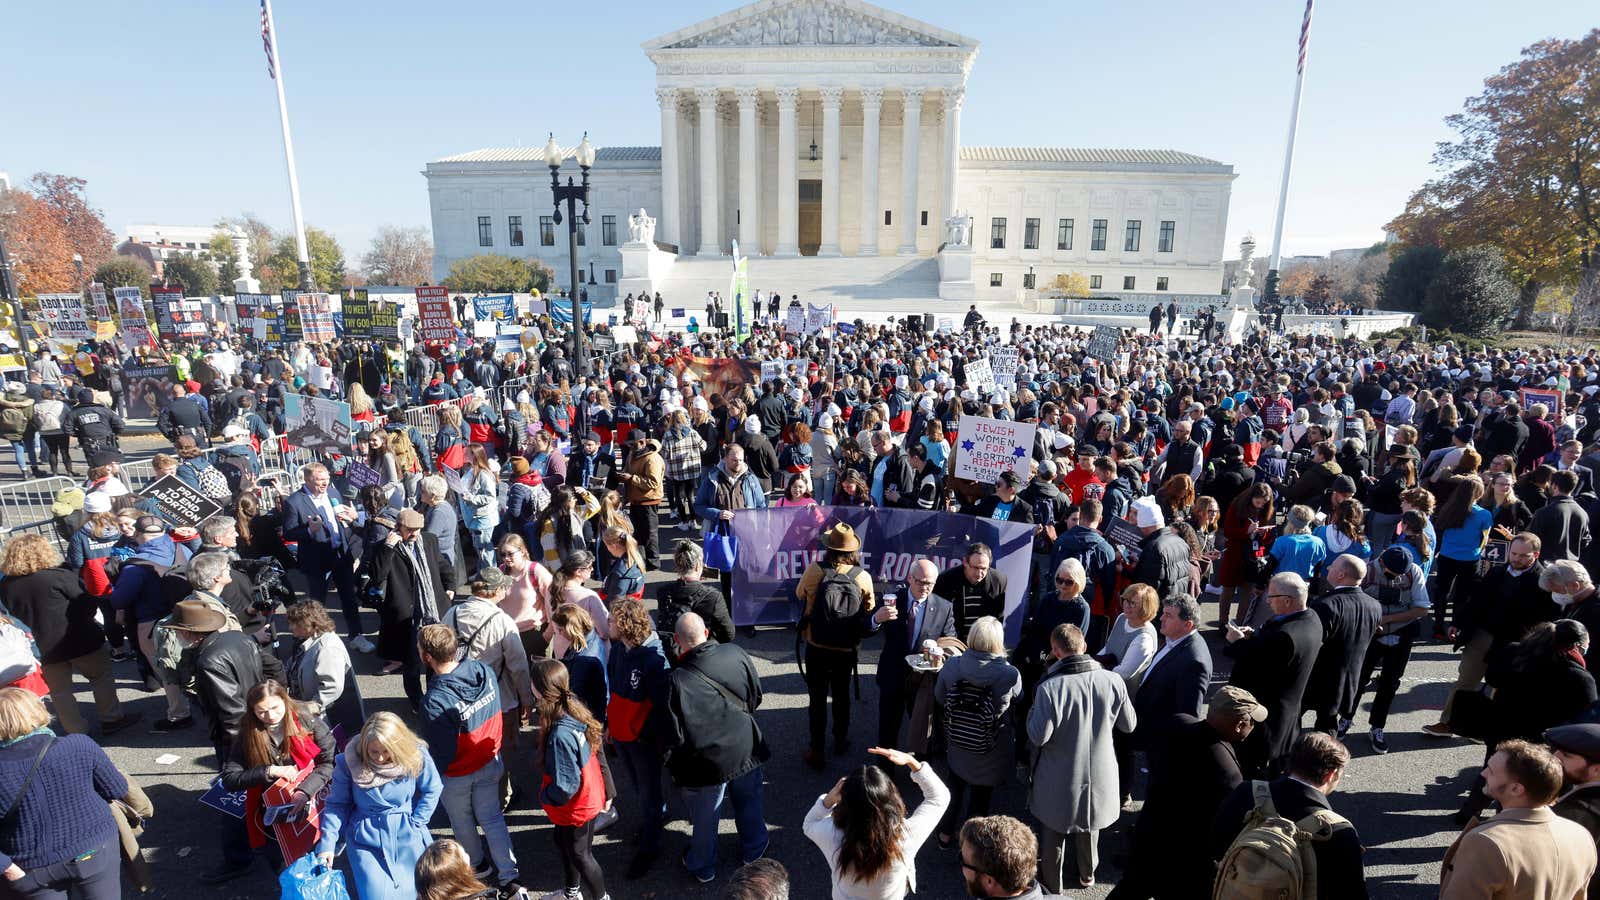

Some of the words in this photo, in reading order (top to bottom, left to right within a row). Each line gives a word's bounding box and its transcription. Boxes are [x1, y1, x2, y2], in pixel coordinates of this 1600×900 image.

[61, 310, 70, 319] IS
[371, 314, 398, 326] JESUS
[49, 321, 88, 331] MURDER
[423, 318, 452, 329] JESUS
[425, 329, 454, 339] CHRIST
[964, 360, 985, 374] EVERY
[993, 356, 1018, 367] VOICE
[976, 423, 1015, 437] JEWISH
[974, 433, 1015, 448] WOMEN
[985, 444, 1006, 454] FOR
[969, 450, 1017, 465] ABORTION
[972, 457, 1014, 471] RIGHTS
[166, 487, 180, 499] TO
[179, 497, 200, 512] END
[177, 486, 204, 504] PRAY
[150, 489, 202, 522] ABORTION
